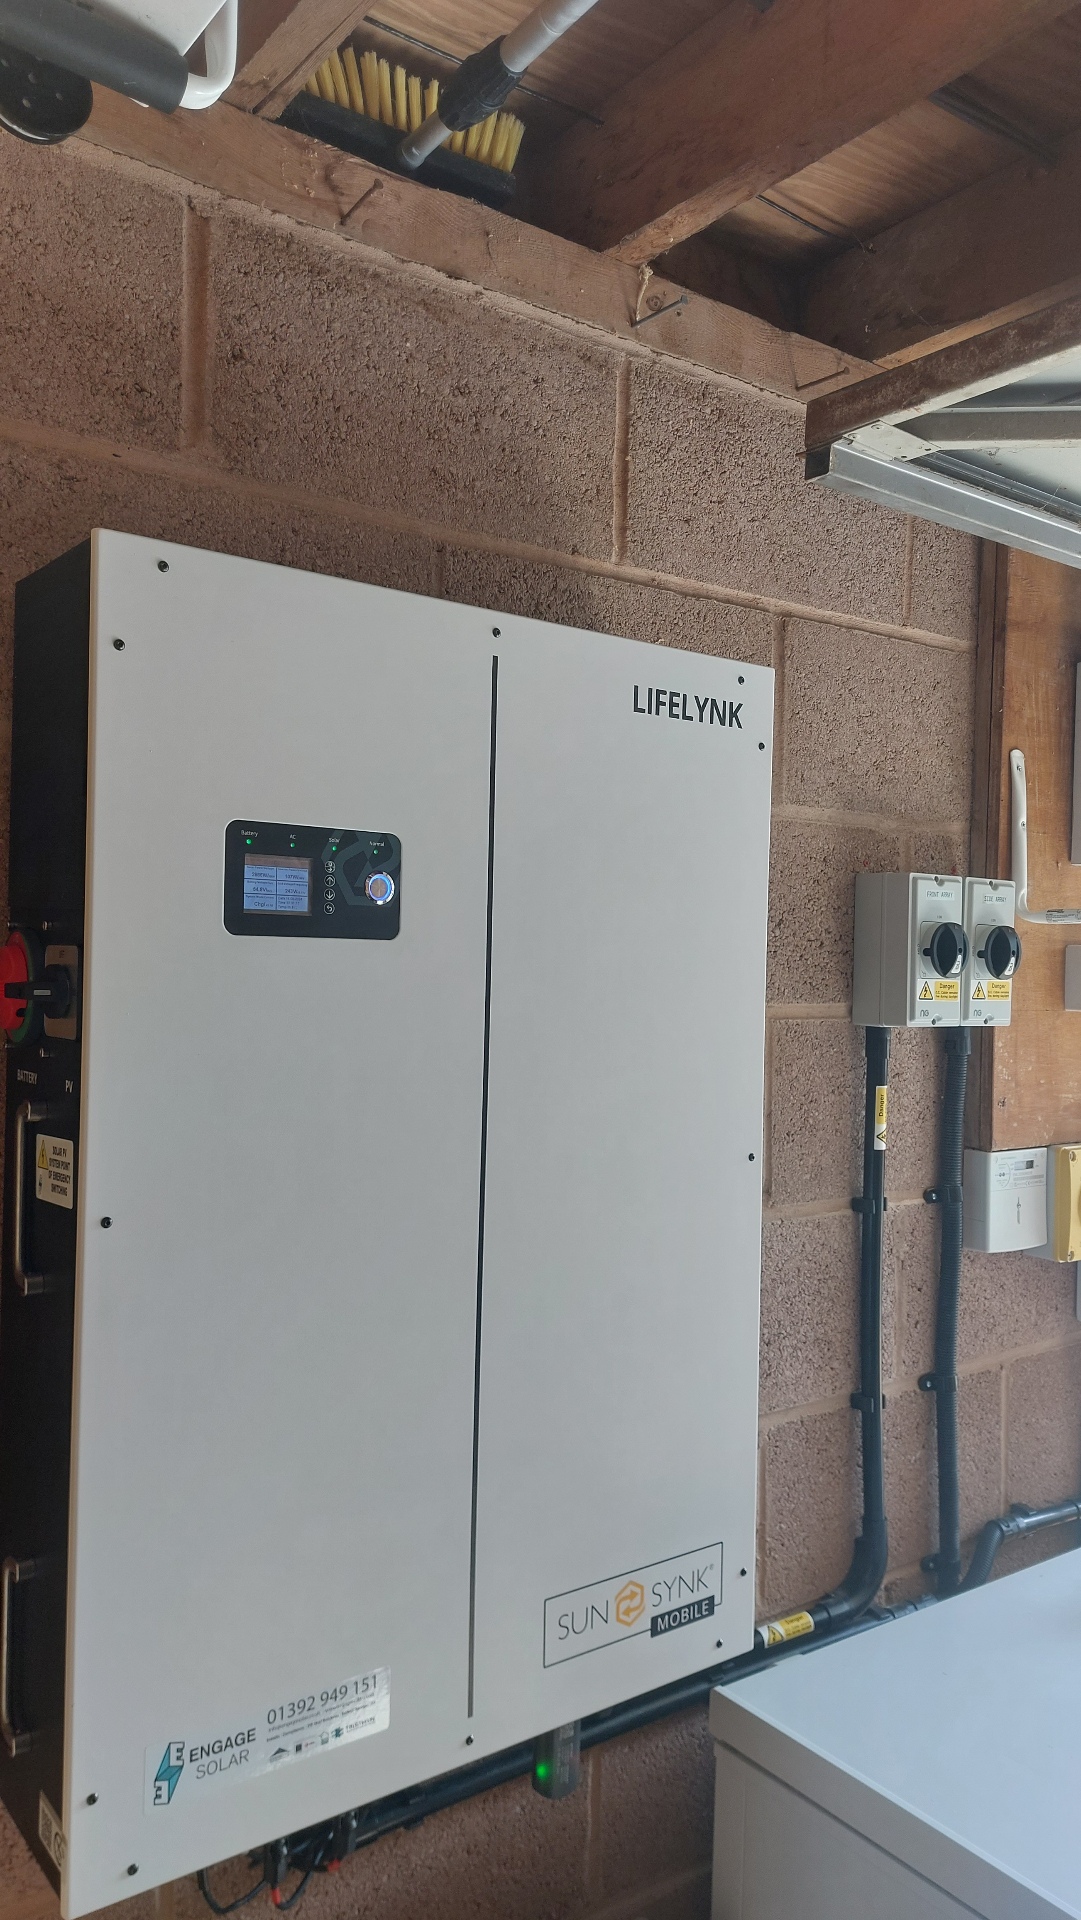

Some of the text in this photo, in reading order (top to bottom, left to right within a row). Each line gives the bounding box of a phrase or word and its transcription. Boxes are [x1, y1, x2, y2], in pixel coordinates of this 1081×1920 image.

[633, 685, 743, 729] LIFELYNK
[17, 1069, 38, 1085] BATTERY
[65, 1079, 74, 1093] PV
[52, 1145, 67, 1158] SOLAR PV
[49, 1157, 70, 1171] SYSTEM POINT
[52, 1171, 71, 1184] EMERGENCY
[51, 1183, 67, 1197] SWITCHING
[558, 1599, 608, 1640] SUN
[657, 1600, 709, 1632] MOBILE
[267, 1696, 315, 1725] 01392
[320, 1684, 348, 1707] 949
[354, 1674, 377, 1695] 151
[189, 1727, 256, 1763] ENGAGE
[196, 1749, 250, 1780] SOLAR
